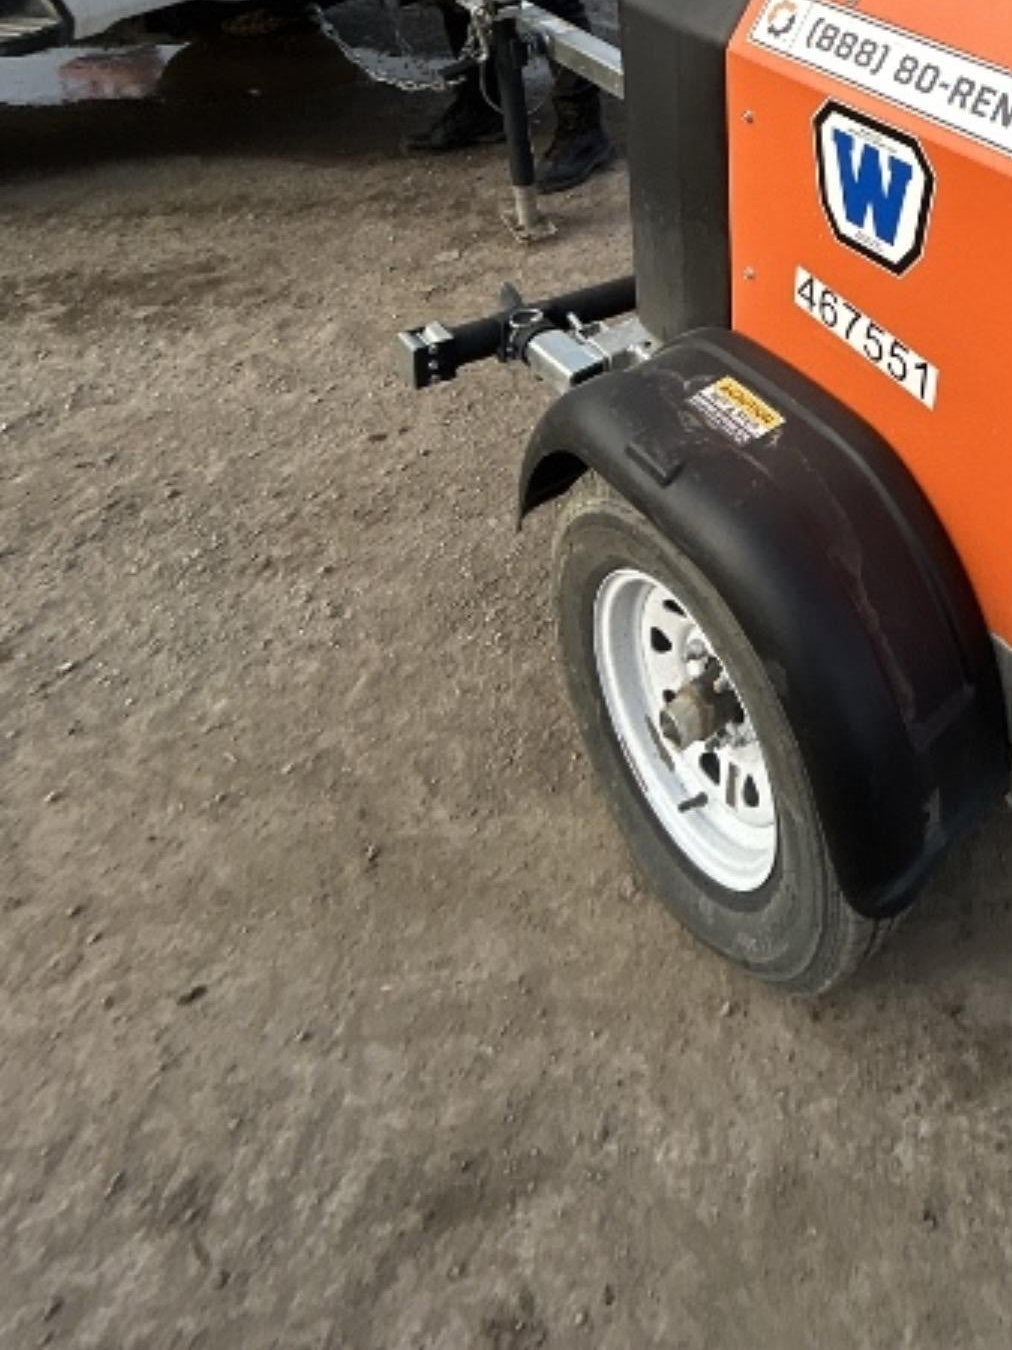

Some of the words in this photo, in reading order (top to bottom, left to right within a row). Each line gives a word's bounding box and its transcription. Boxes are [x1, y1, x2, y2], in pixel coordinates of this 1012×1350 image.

[805, 16, 890, 87] (888)
[833, 128, 913, 248] W
[797, 276, 929, 399] 467551
